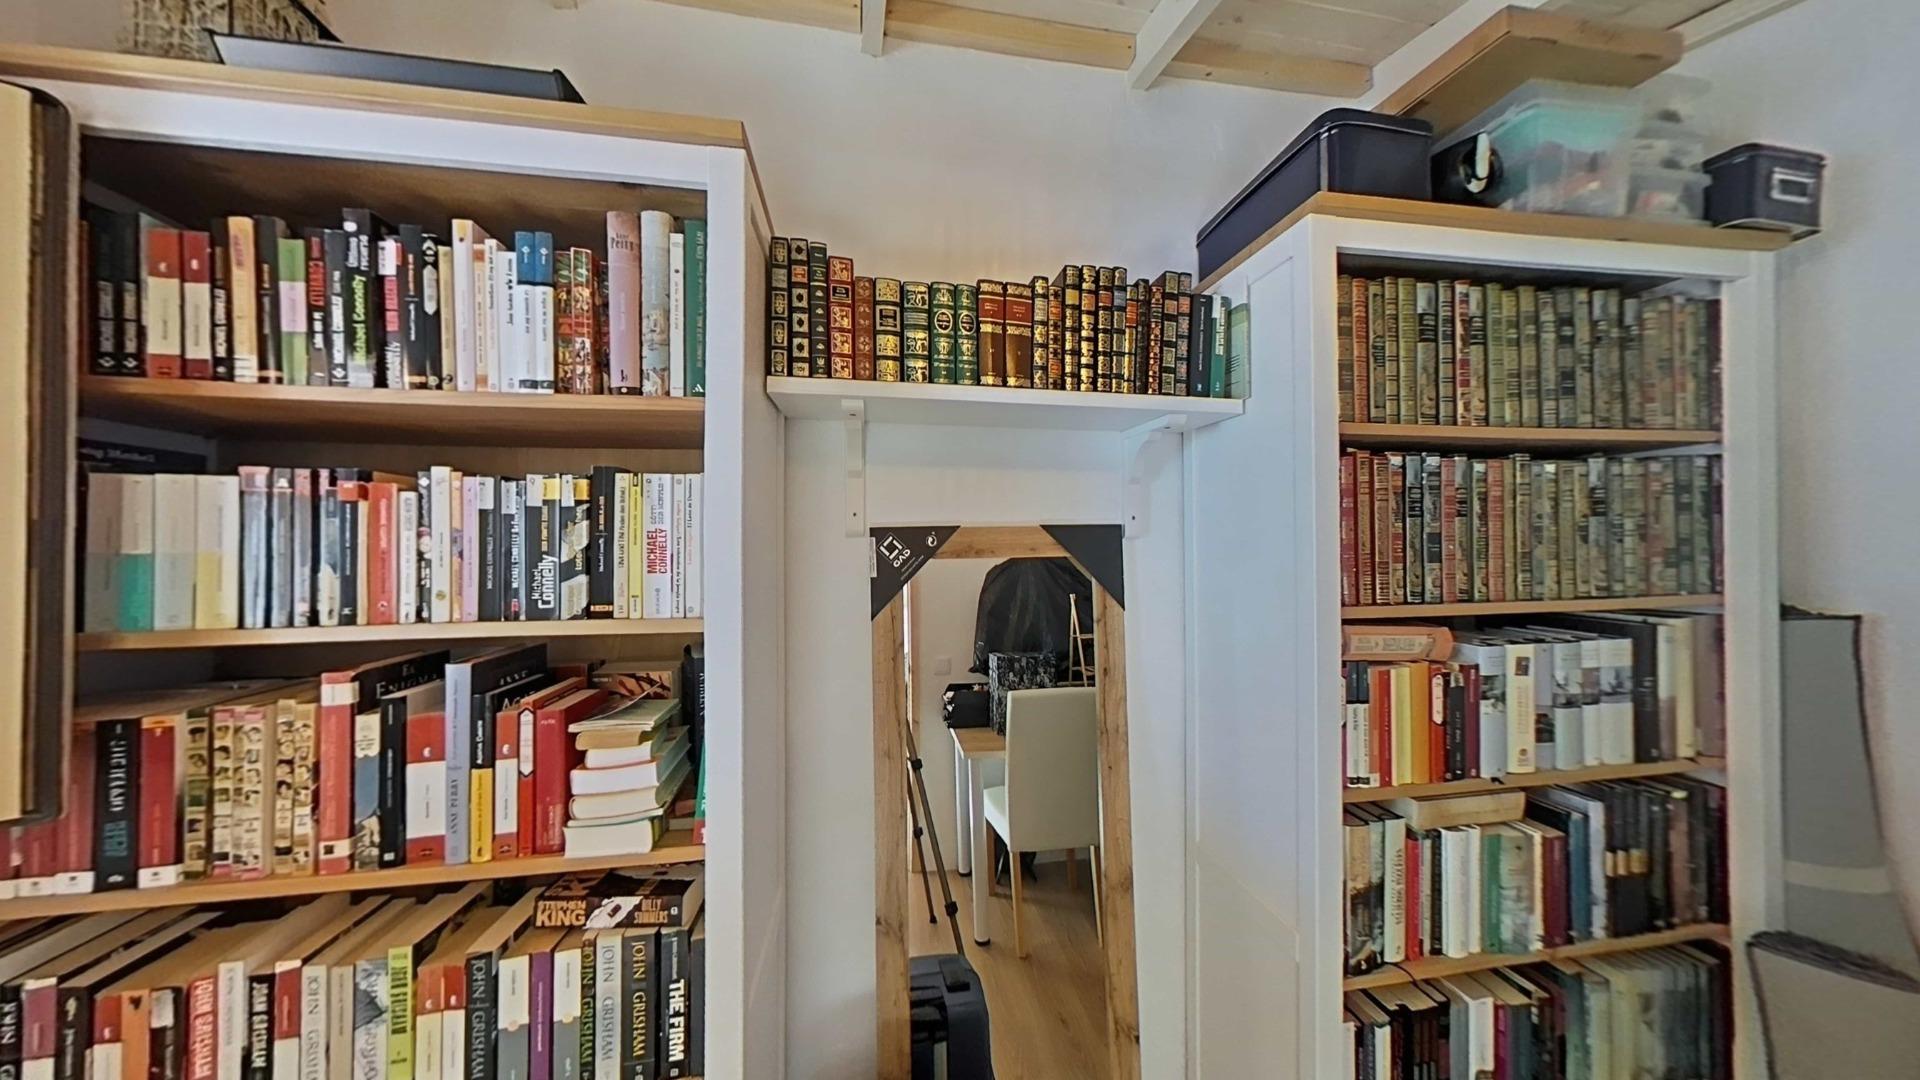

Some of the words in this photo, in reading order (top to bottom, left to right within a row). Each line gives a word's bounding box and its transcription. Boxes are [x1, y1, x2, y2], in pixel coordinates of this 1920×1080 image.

[646, 528, 658, 574] MICHAEL
[658, 528, 668, 574] CONNELLY
[531, 569, 542, 600] Michael
[537, 554, 559, 609] Connelly
[535, 909, 586, 927] KING
[537, 899, 586, 911] STEPHEN
[471, 959, 486, 998] JOHN
[601, 945, 614, 983] JOHN
[631, 942, 646, 979] JOHN
[306, 975, 321, 1015] JOHN
[668, 978, 684, 1015] THE
[601, 996, 614, 1062] GRISHAM
[632, 991, 647, 1057] GRISHAM
[668, 1016, 684, 1062] FIRM
[471, 1010, 486, 1079] GRISHAM
